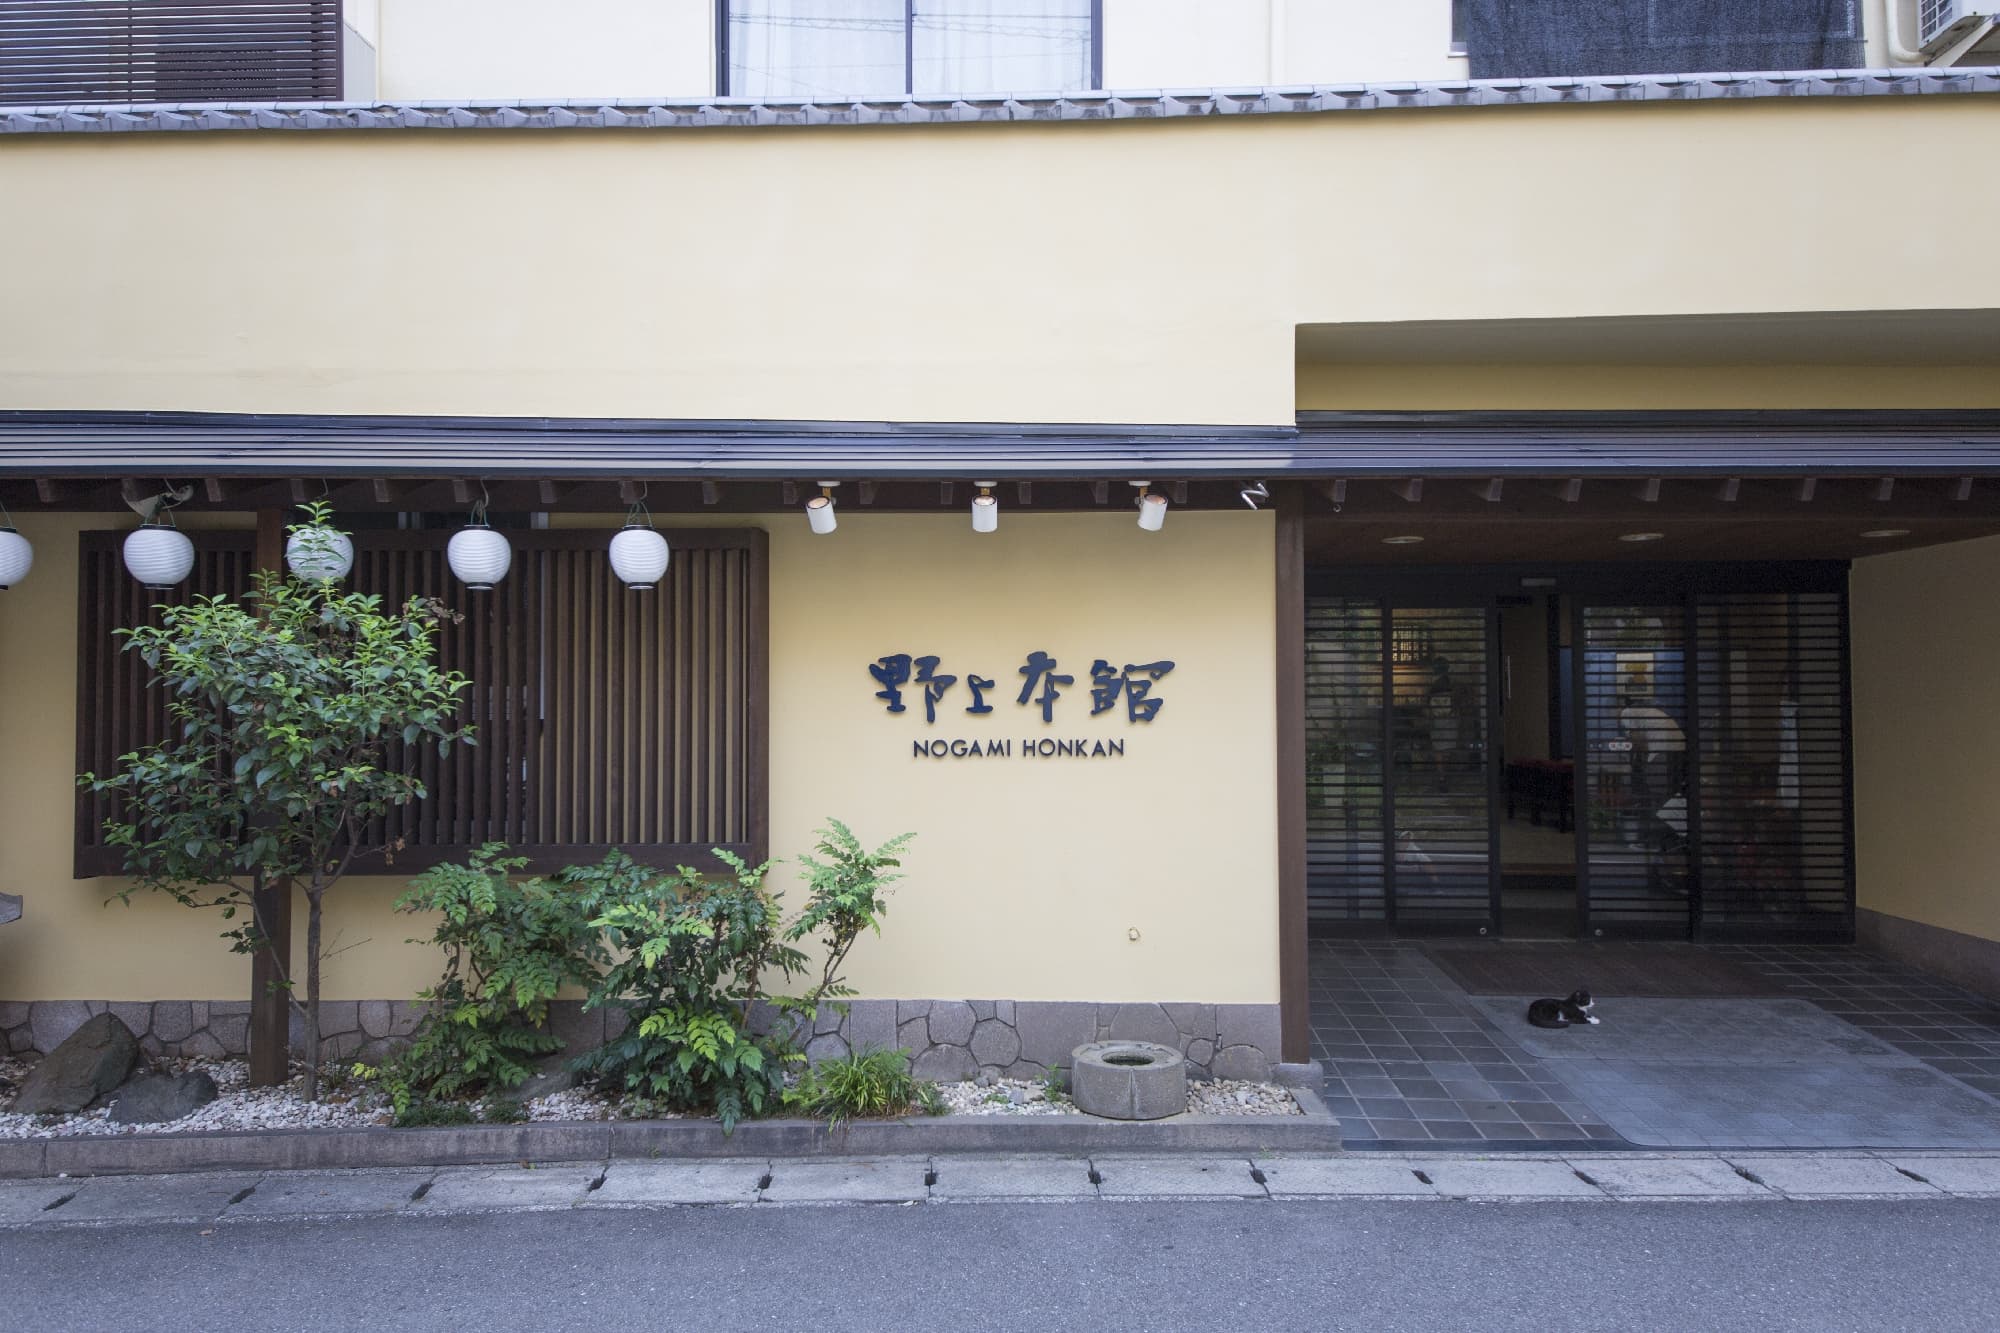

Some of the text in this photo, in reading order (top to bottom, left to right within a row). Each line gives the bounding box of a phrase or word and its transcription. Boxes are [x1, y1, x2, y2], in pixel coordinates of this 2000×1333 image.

[868, 651, 1175, 723] 野上本館
[913, 738, 1124, 758] NOGAMI HONKAN
